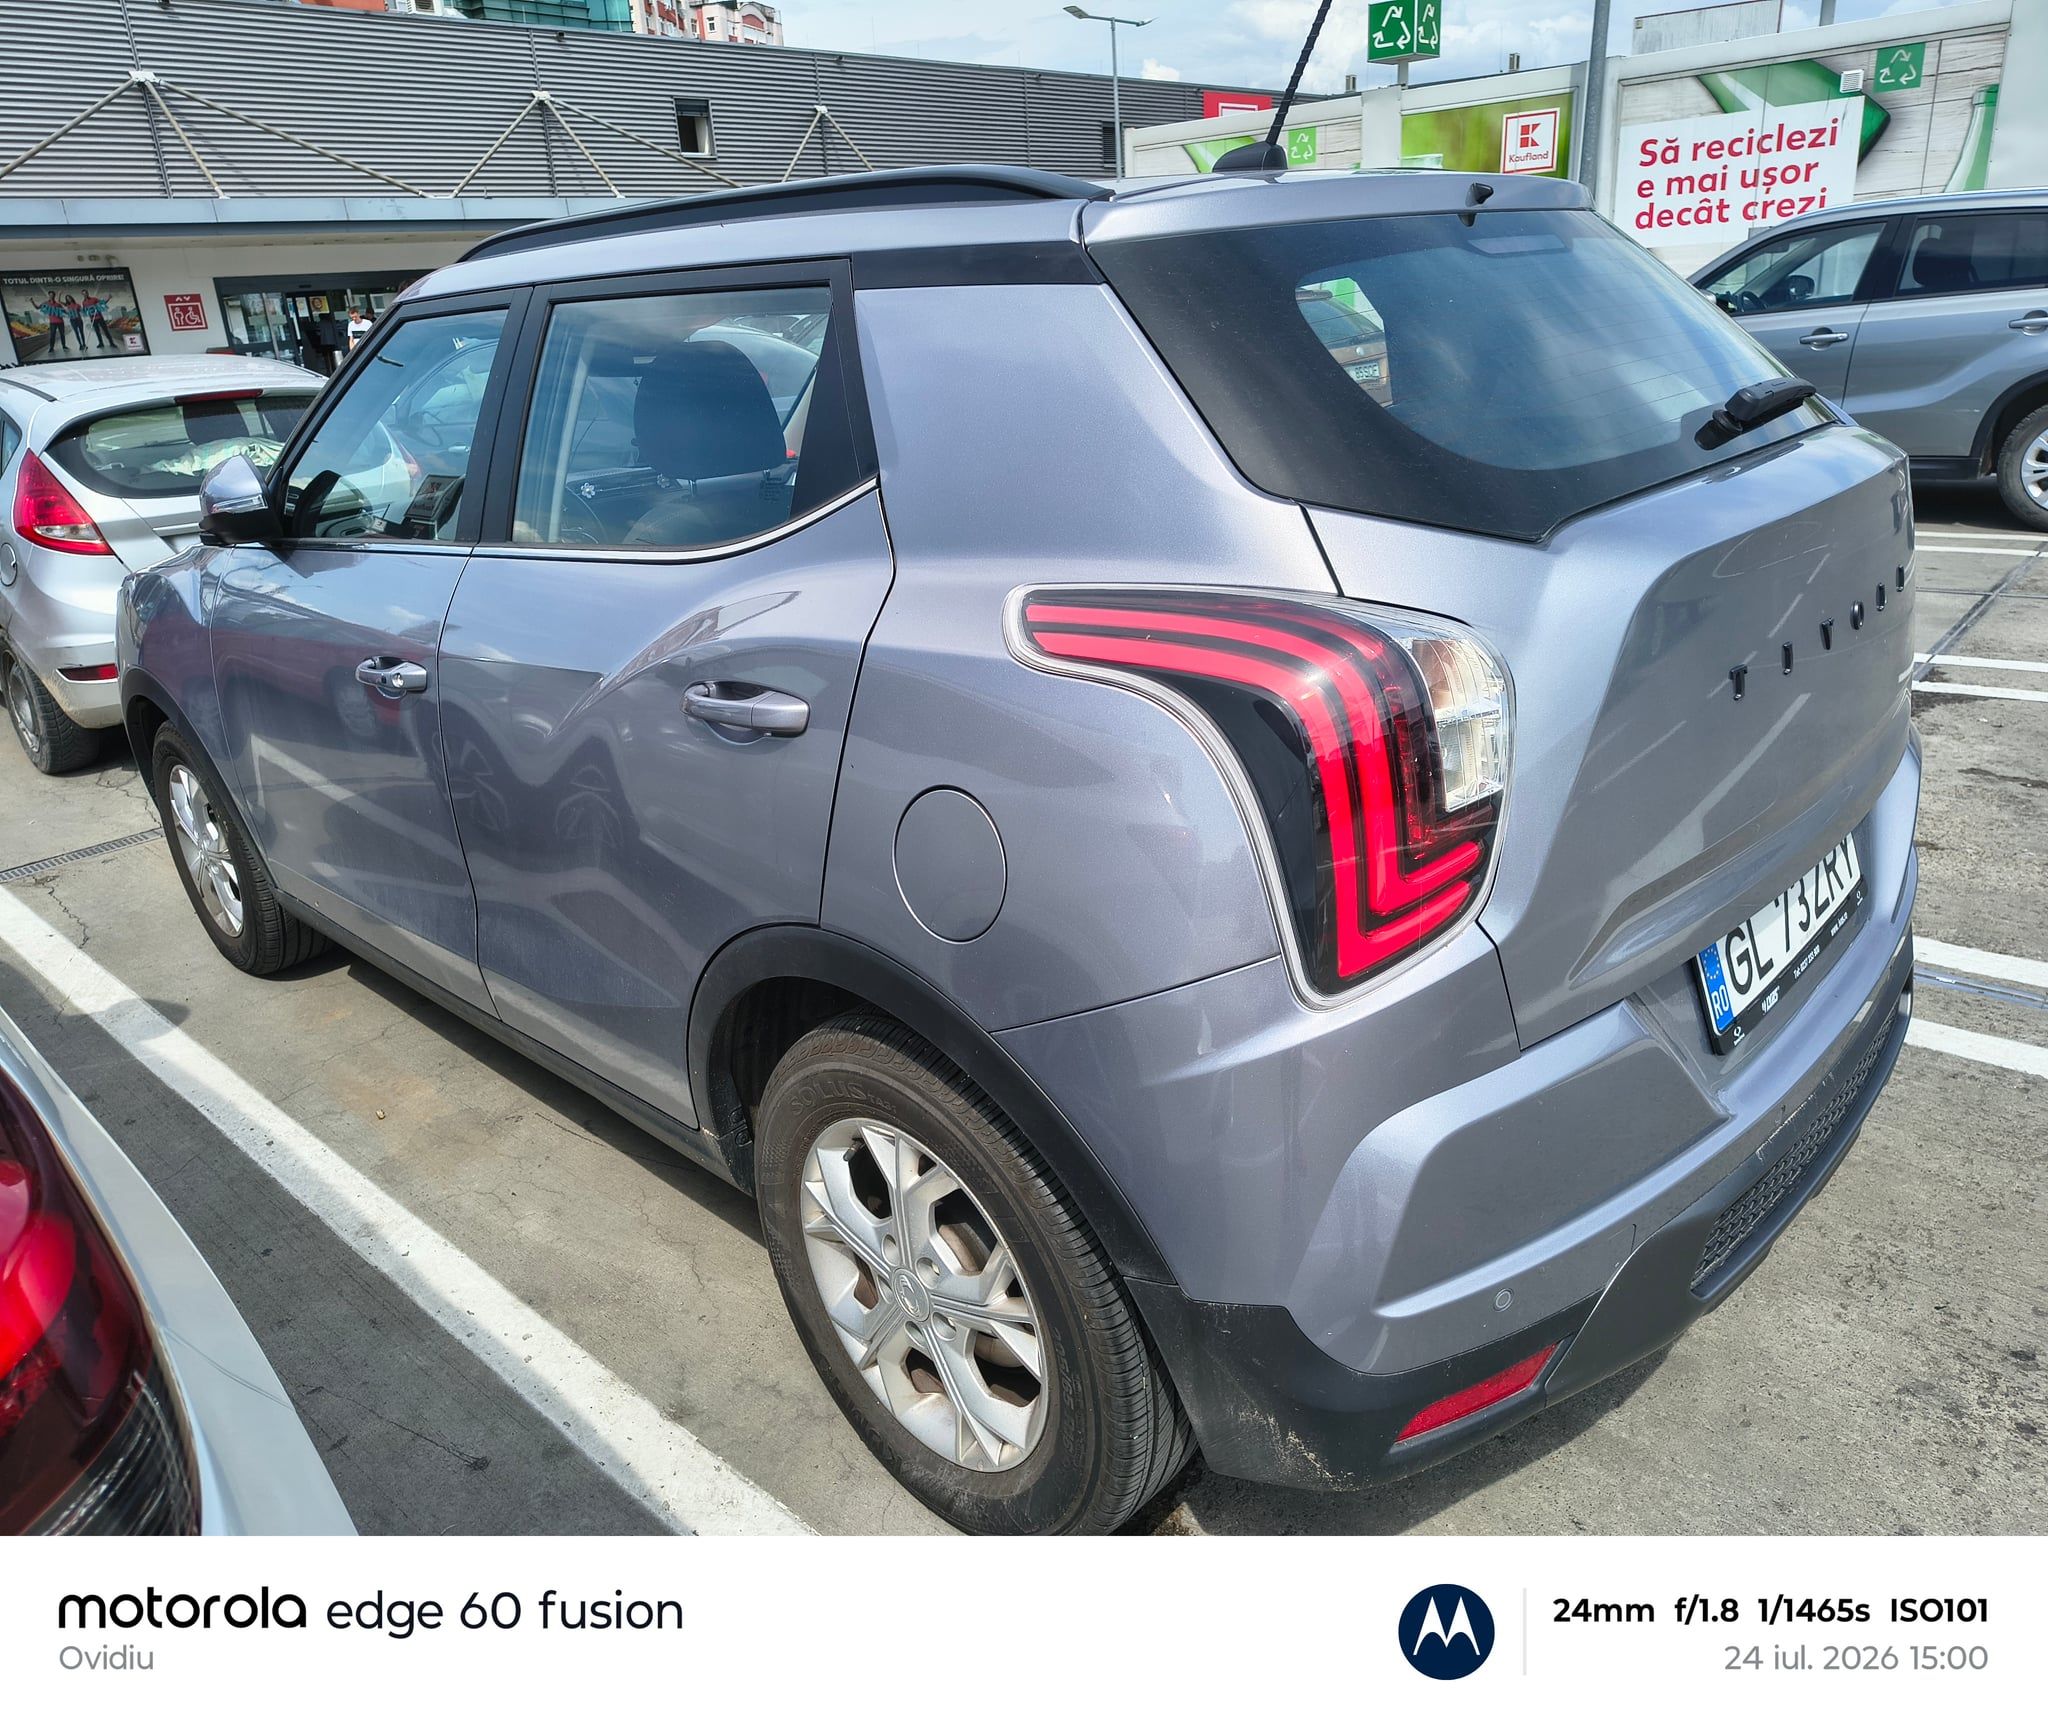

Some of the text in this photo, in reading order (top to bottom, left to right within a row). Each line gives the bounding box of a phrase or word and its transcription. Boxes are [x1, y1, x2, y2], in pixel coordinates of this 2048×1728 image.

[1508, 151, 1549, 163] Kaufland
[1639, 117, 1839, 167] Să reciclezi
[1637, 161, 1819, 199] e mai ușor
[1635, 187, 1828, 230] decât crezi
[3, 277, 29, 285] TOTUL
[1725, 918, 1774, 995] GL
[1711, 984, 1730, 1020] RO
[790, 1080, 867, 1115] SOLUS
